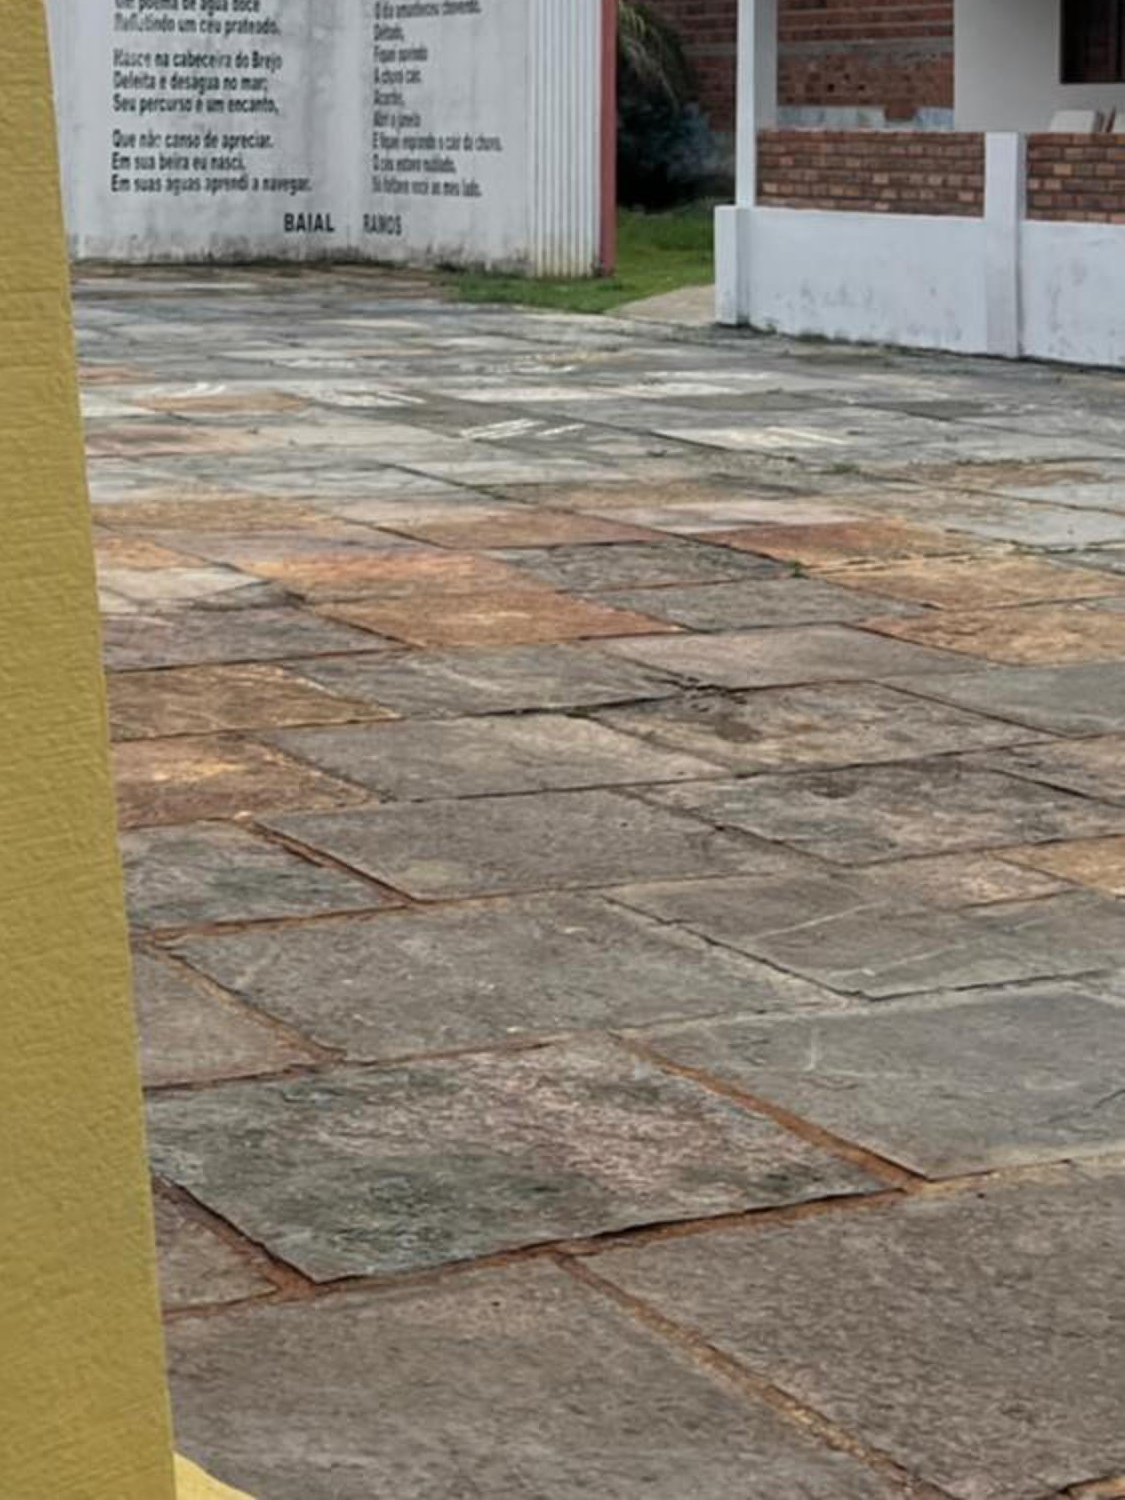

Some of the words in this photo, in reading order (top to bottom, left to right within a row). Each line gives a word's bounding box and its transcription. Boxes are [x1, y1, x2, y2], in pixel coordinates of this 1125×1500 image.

[113, 93, 136, 112] Seu
[113, 129, 136, 148] Que
[165, 133, 200, 148] canso
[203, 130, 219, 148] de
[112, 152, 131, 170] Em
[134, 156, 156, 170] sua
[111, 174, 131, 192] Em
[134, 177, 161, 192] suas
[284, 212, 335, 233] BAIAL
[363, 213, 403, 236] RAMOS
